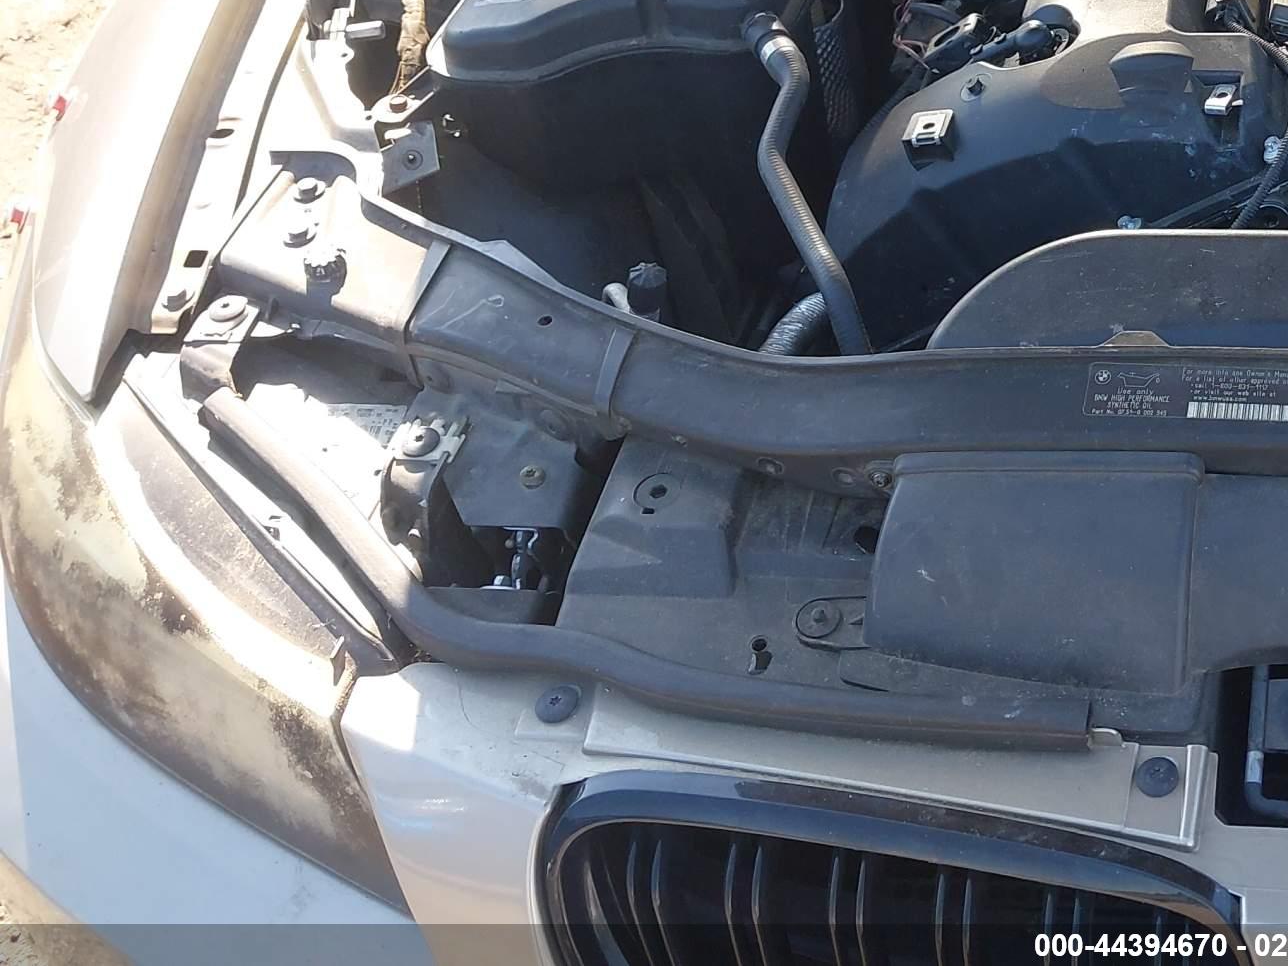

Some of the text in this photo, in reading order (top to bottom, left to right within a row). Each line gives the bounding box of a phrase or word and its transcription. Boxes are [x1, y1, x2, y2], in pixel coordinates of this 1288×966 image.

[1136, 387, 1154, 396] only
[1094, 394, 1171, 403] BMW HIGH PERFORMANCE
